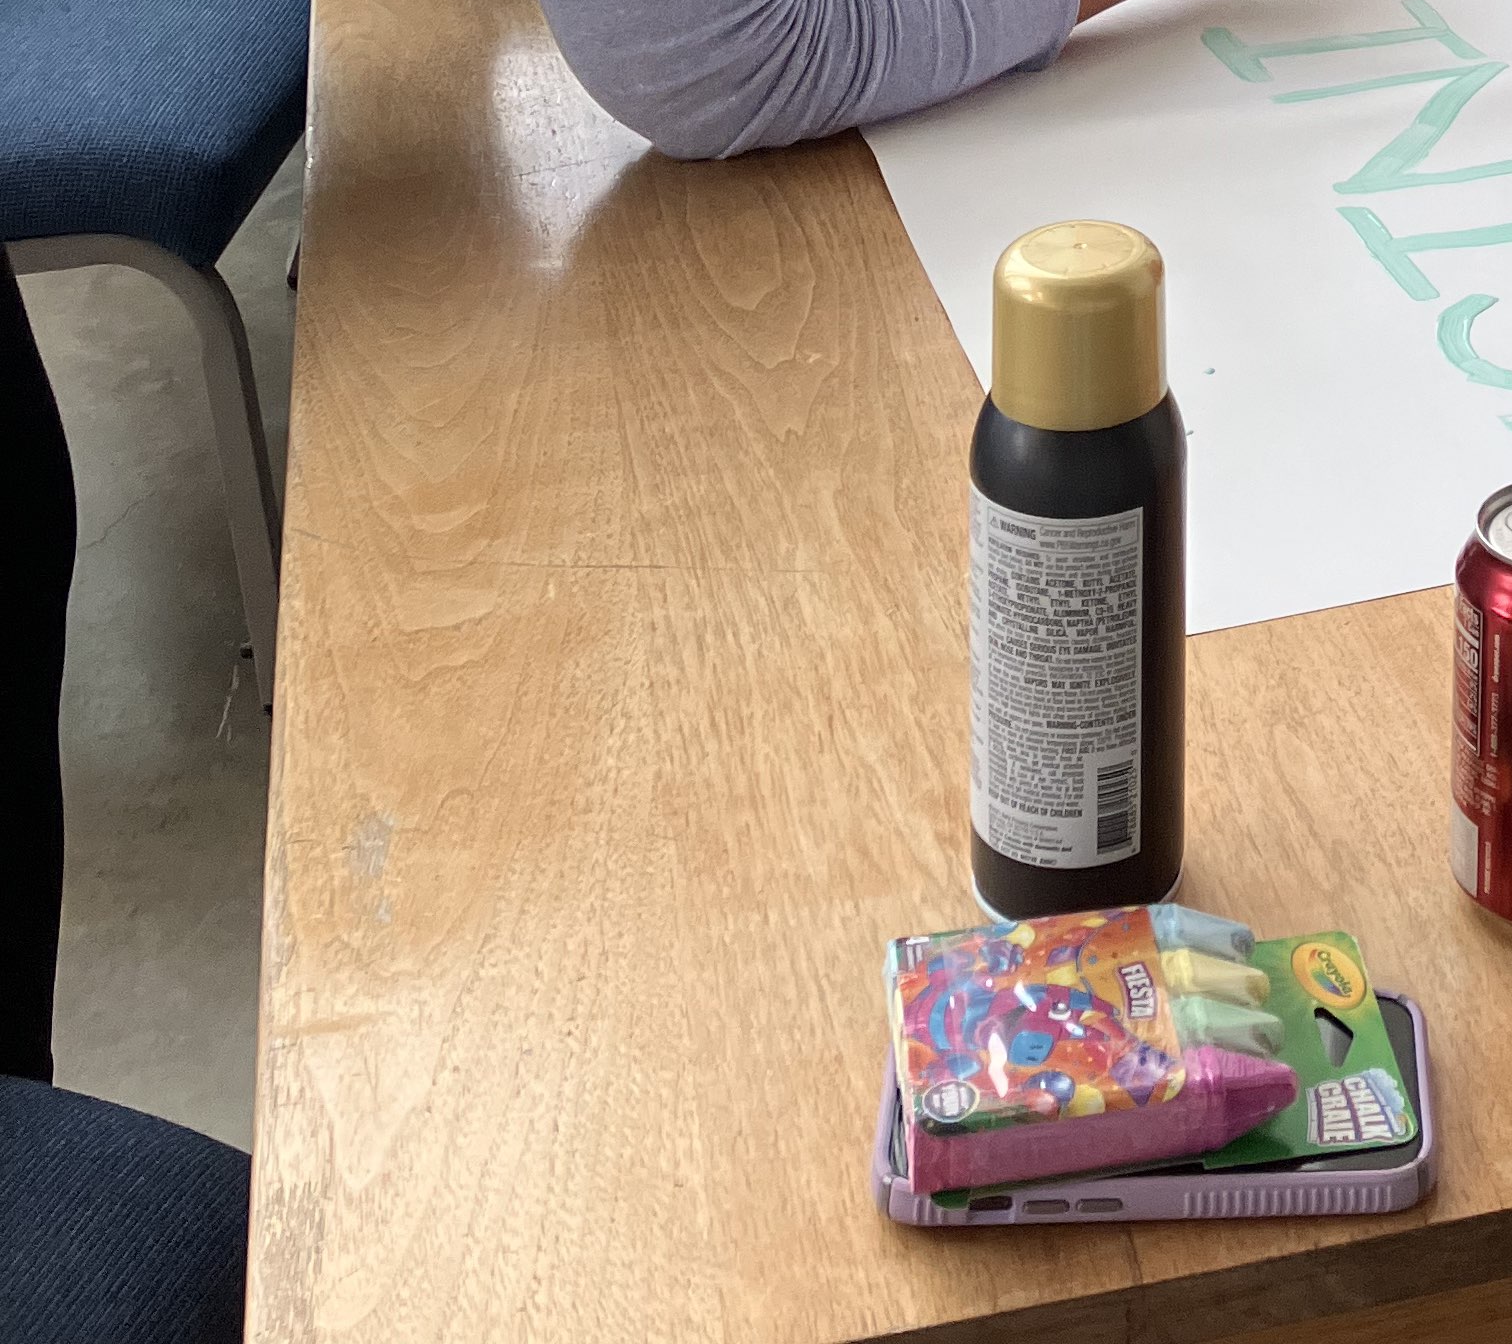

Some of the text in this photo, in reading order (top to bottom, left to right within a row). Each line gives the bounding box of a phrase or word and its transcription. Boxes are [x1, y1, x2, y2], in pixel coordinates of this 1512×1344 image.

[999, 519, 1036, 540] WARNING
[1121, 963, 1155, 1017] FIESTA
[1318, 1082, 1356, 1142] CRAIE
[1344, 1076, 1393, 1141] CHALK
